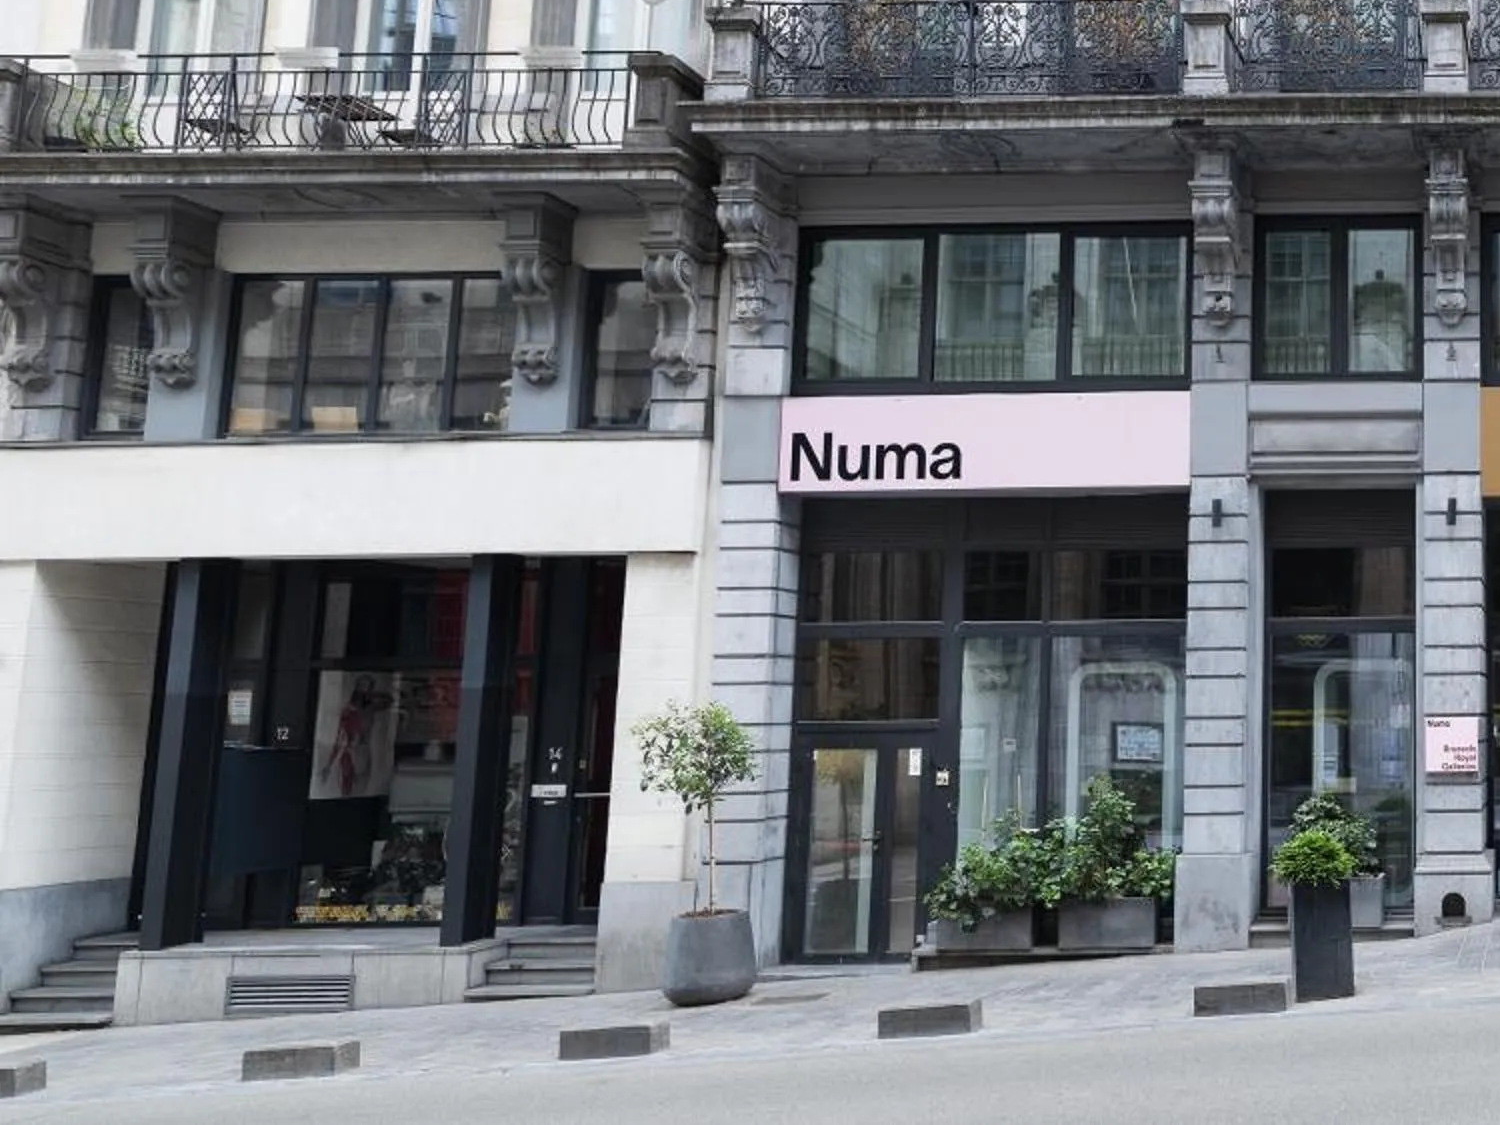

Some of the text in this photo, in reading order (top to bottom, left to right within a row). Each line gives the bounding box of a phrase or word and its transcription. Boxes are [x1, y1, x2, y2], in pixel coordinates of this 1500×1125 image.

[789, 431, 962, 482] Numa
[1427, 720, 1451, 728] Numa
[276, 727, 289, 740] 12
[1441, 762, 1477, 770] Galleries
